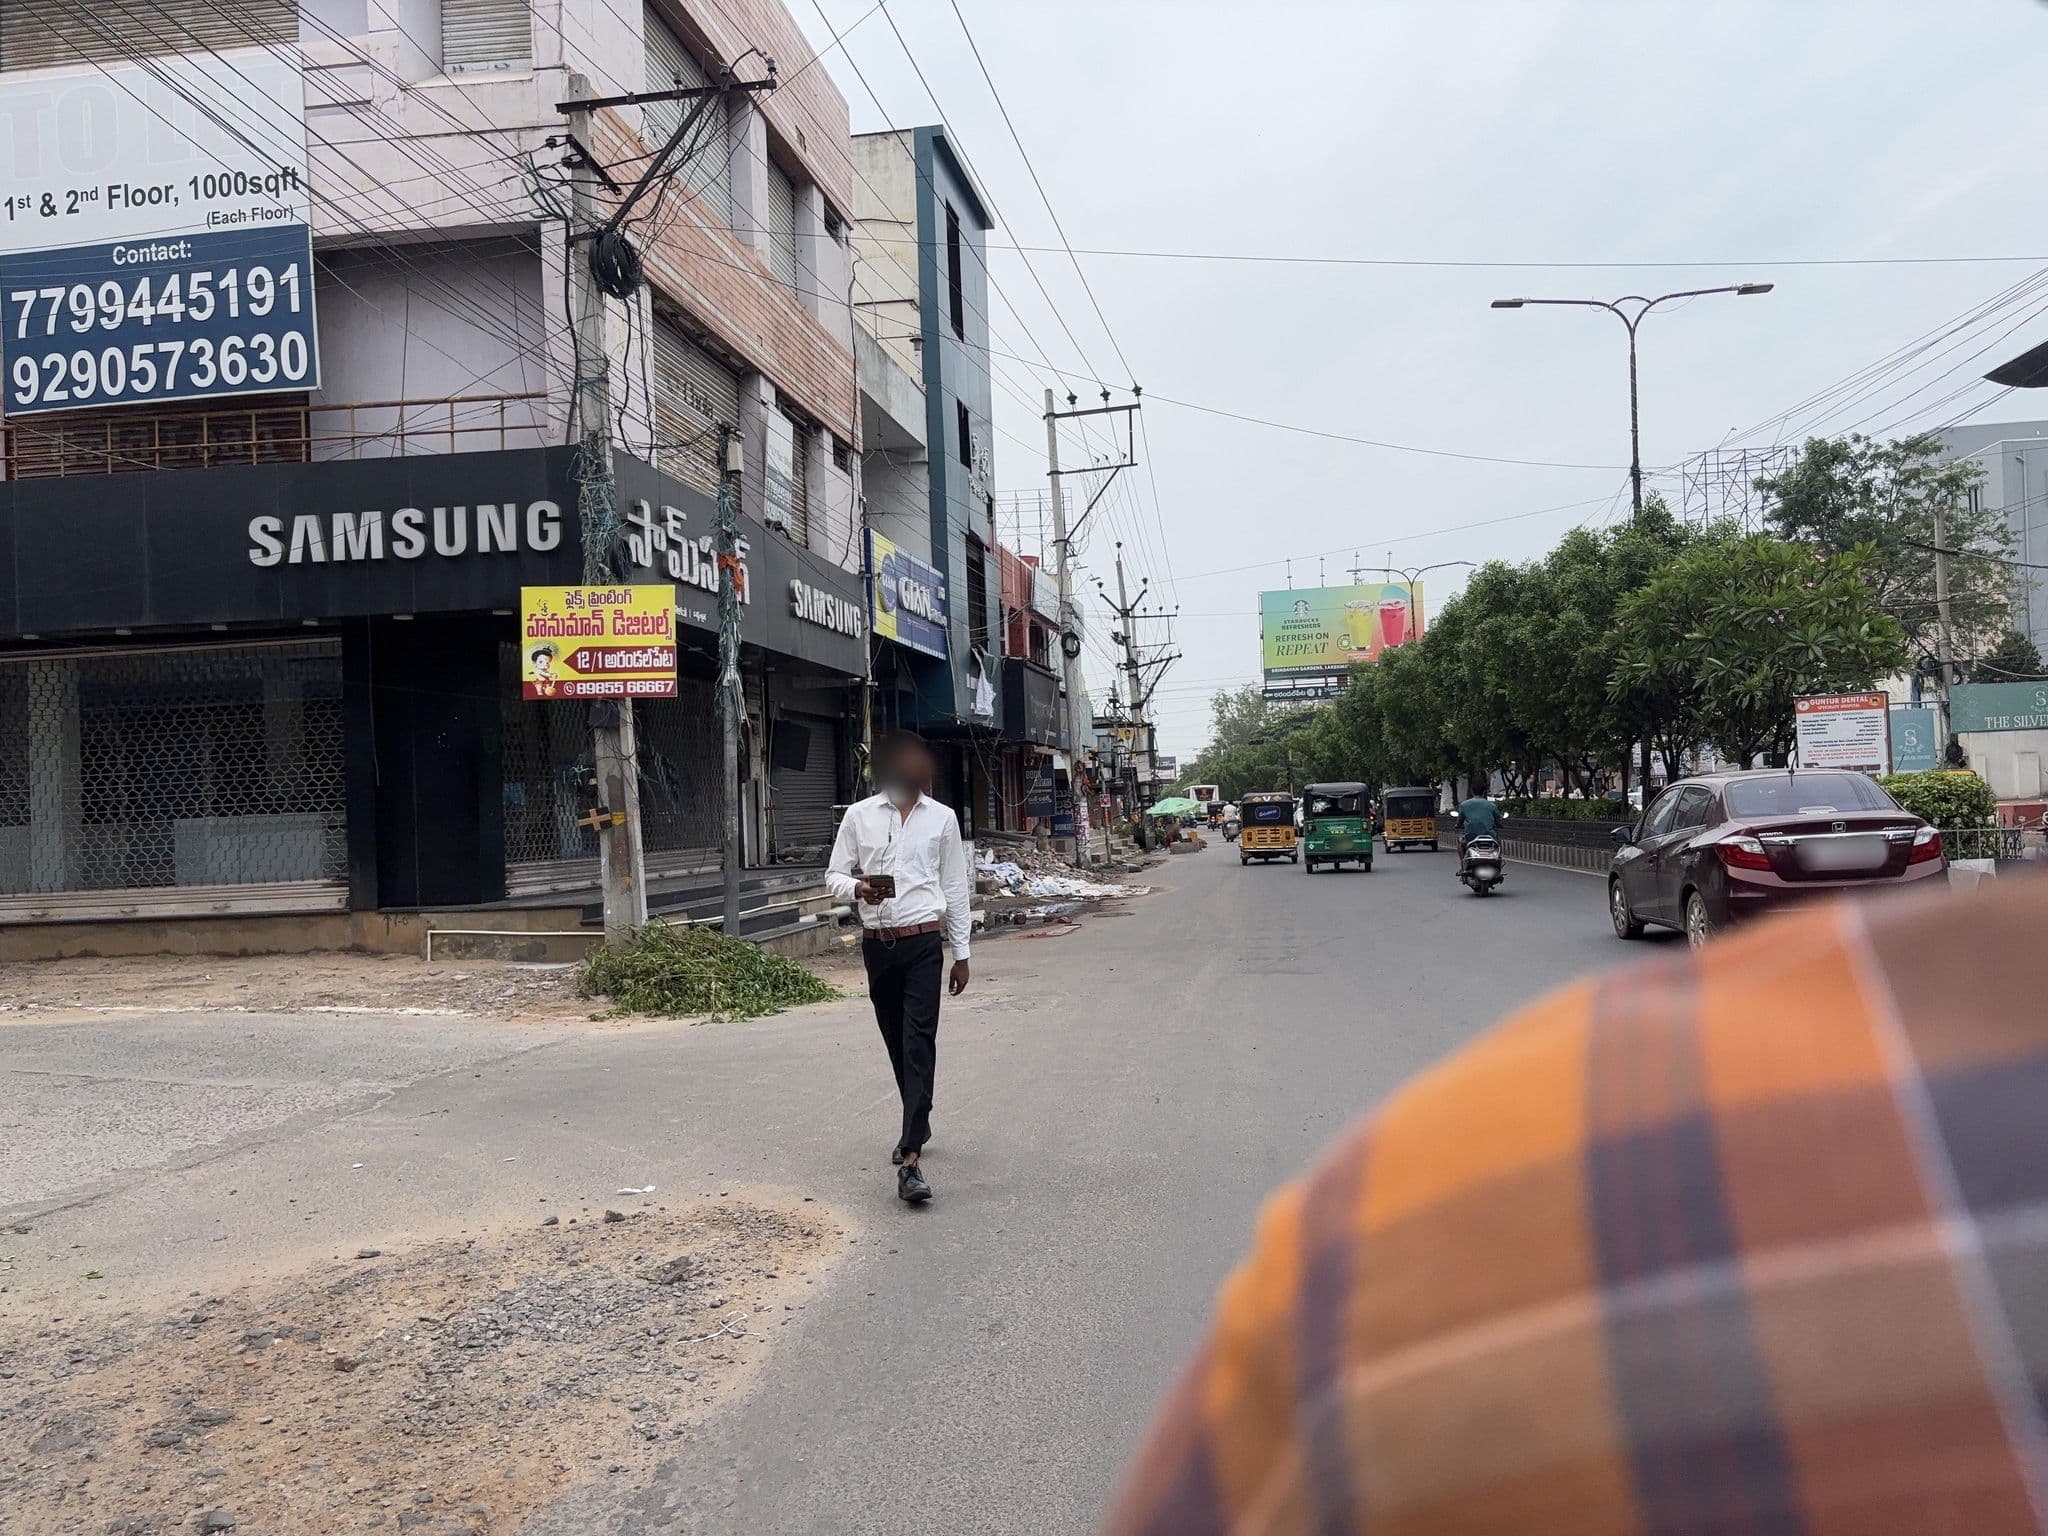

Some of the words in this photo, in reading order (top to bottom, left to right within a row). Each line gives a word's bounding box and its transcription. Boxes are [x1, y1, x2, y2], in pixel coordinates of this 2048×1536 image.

[3, 194, 32, 221] 1st
[39, 192, 58, 218] &
[65, 186, 99, 215] 2nd
[108, 182, 179, 210] Floor,
[188, 166, 299, 201] 1000sqft
[206, 209, 247, 229] (Each
[251, 204, 294, 224] Floor)
[112, 240, 192, 266] Contact:
[11, 263, 301, 339] 7799445191
[12, 331, 308, 405] 9290573630
[248, 500, 563, 568] SAMSUNG
[790, 579, 861, 639] SAMSUNG
[527, 610, 605, 638] హనుమాన్
[1275, 633, 1314, 643] REFRESH
[1315, 632, 1329, 640] ON
[1276, 642, 1329, 656] REPEAT
[576, 681, 624, 695] 89855
[627, 680, 674, 694] 66667
[1809, 697, 1840, 706] GUNTUR
[1841, 695, 1868, 704] DENTAL
[1984, 715, 2010, 728] THE
